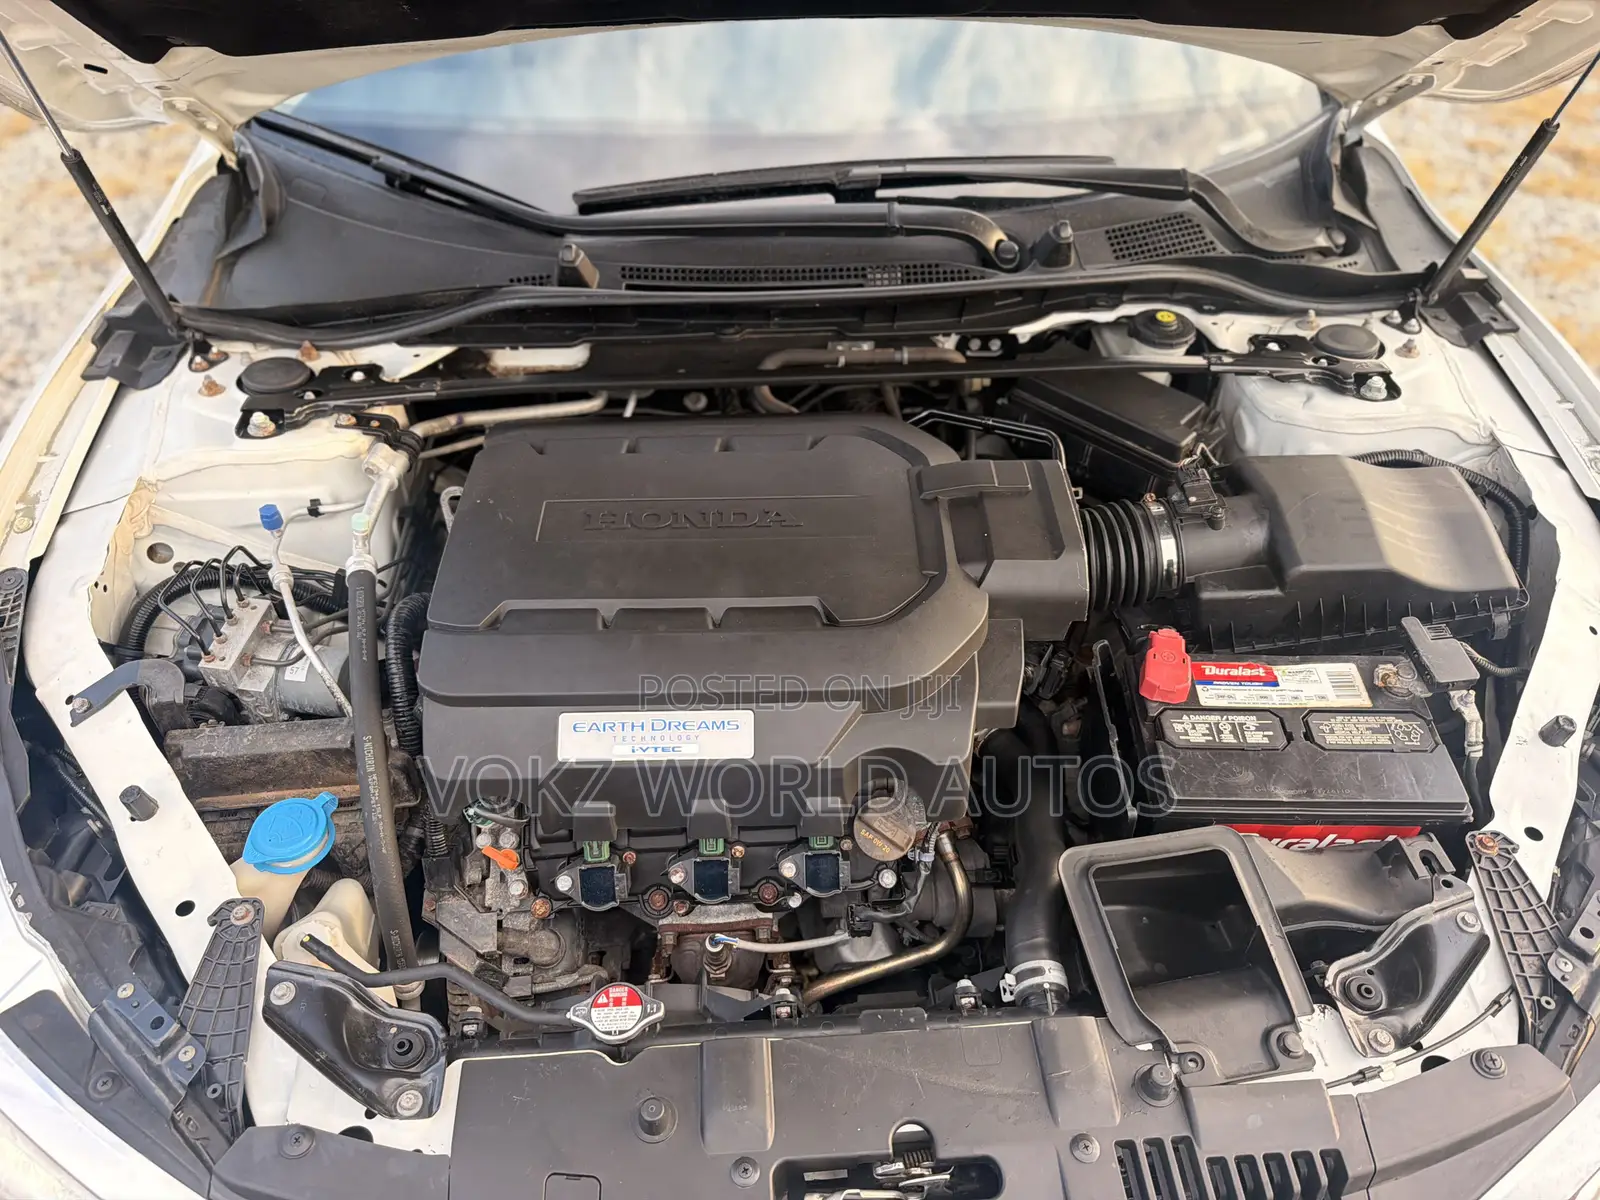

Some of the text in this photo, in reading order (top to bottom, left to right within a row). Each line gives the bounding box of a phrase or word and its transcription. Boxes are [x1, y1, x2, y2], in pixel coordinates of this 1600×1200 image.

[583, 509, 804, 530] HONDA
[1201, 665, 1266, 677] Duralast
[572, 718, 740, 733] EARTH DREAMS
[613, 734, 700, 743] TECHNOLOGY
